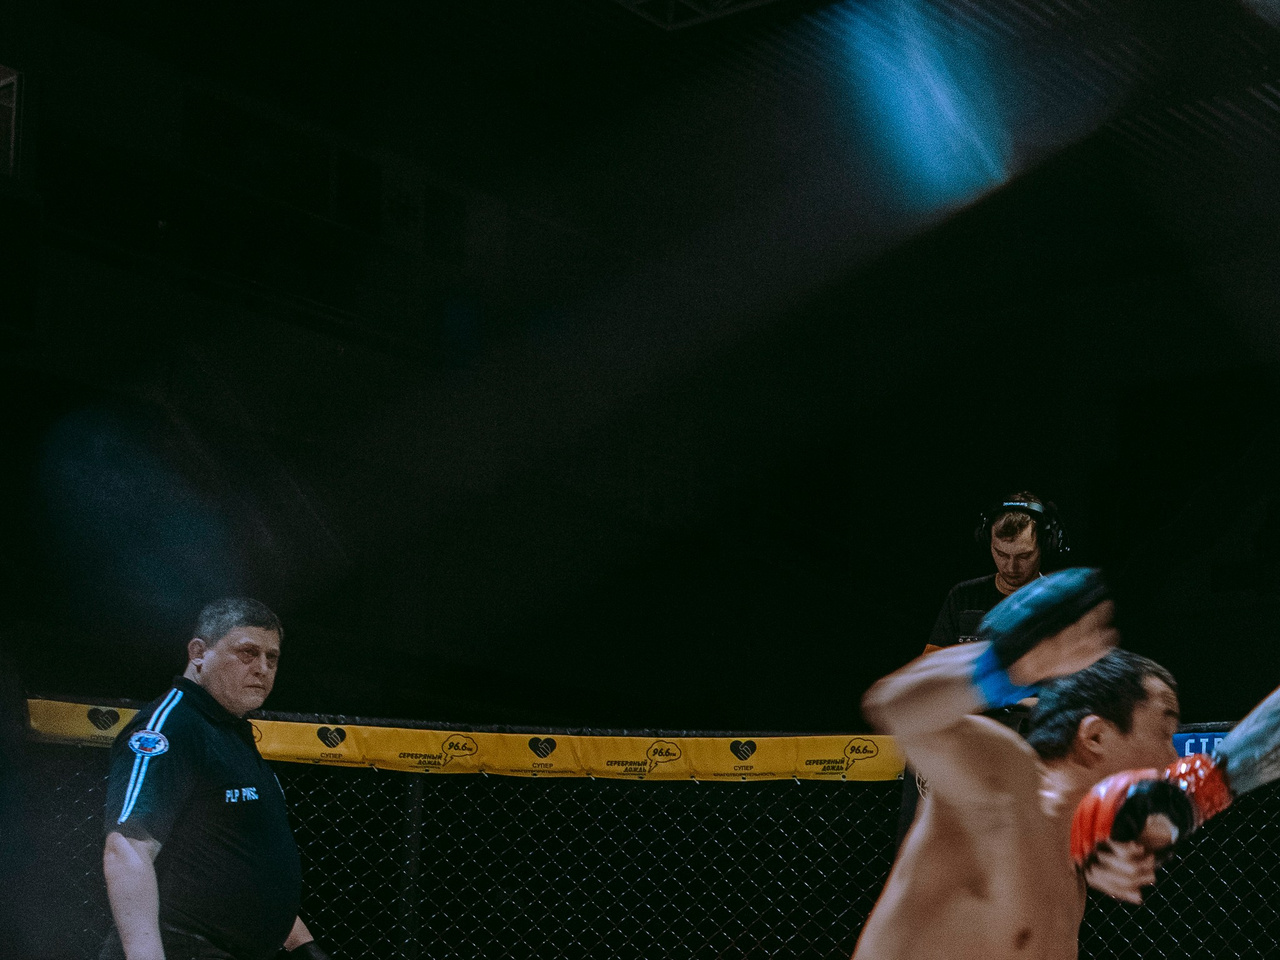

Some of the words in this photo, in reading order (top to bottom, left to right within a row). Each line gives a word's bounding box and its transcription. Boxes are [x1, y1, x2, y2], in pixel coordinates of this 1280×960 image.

[448, 741, 468, 751] 96.6
[849, 745, 868, 754] 96.6
[398, 752, 443, 760] СЕРЕБРЯНЫЙ
[652, 748, 670, 757] 96.6
[606, 759, 647, 767] СЕРЕБРЯНЫЙ
[805, 758, 845, 766] СЕРЕБРЯНЫЙ
[623, 765, 647, 773] ДОЖДЬ
